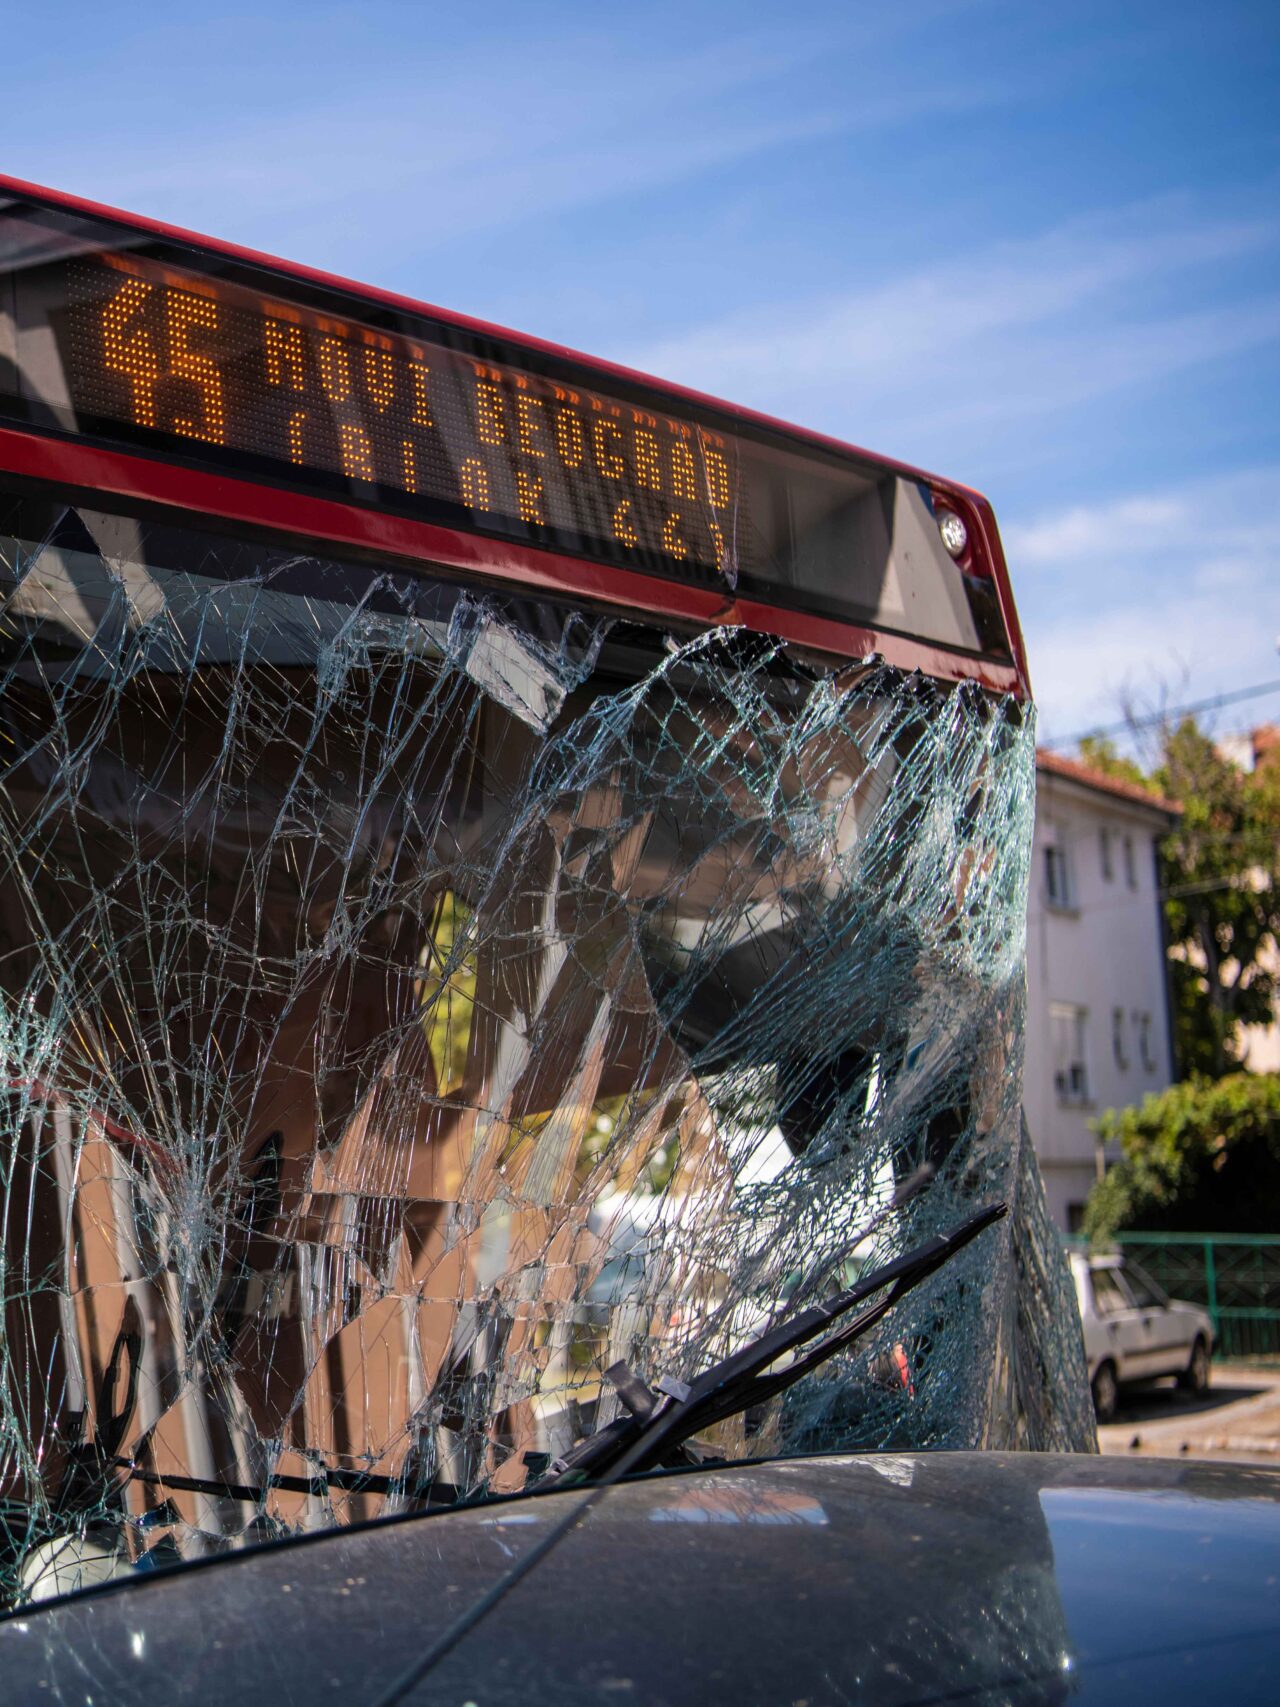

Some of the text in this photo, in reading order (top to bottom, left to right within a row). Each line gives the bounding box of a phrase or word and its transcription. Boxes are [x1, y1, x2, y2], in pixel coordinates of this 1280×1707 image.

[103, 279, 224, 444] 45
[265, 320, 729, 509] NOVI BEOGRAD
